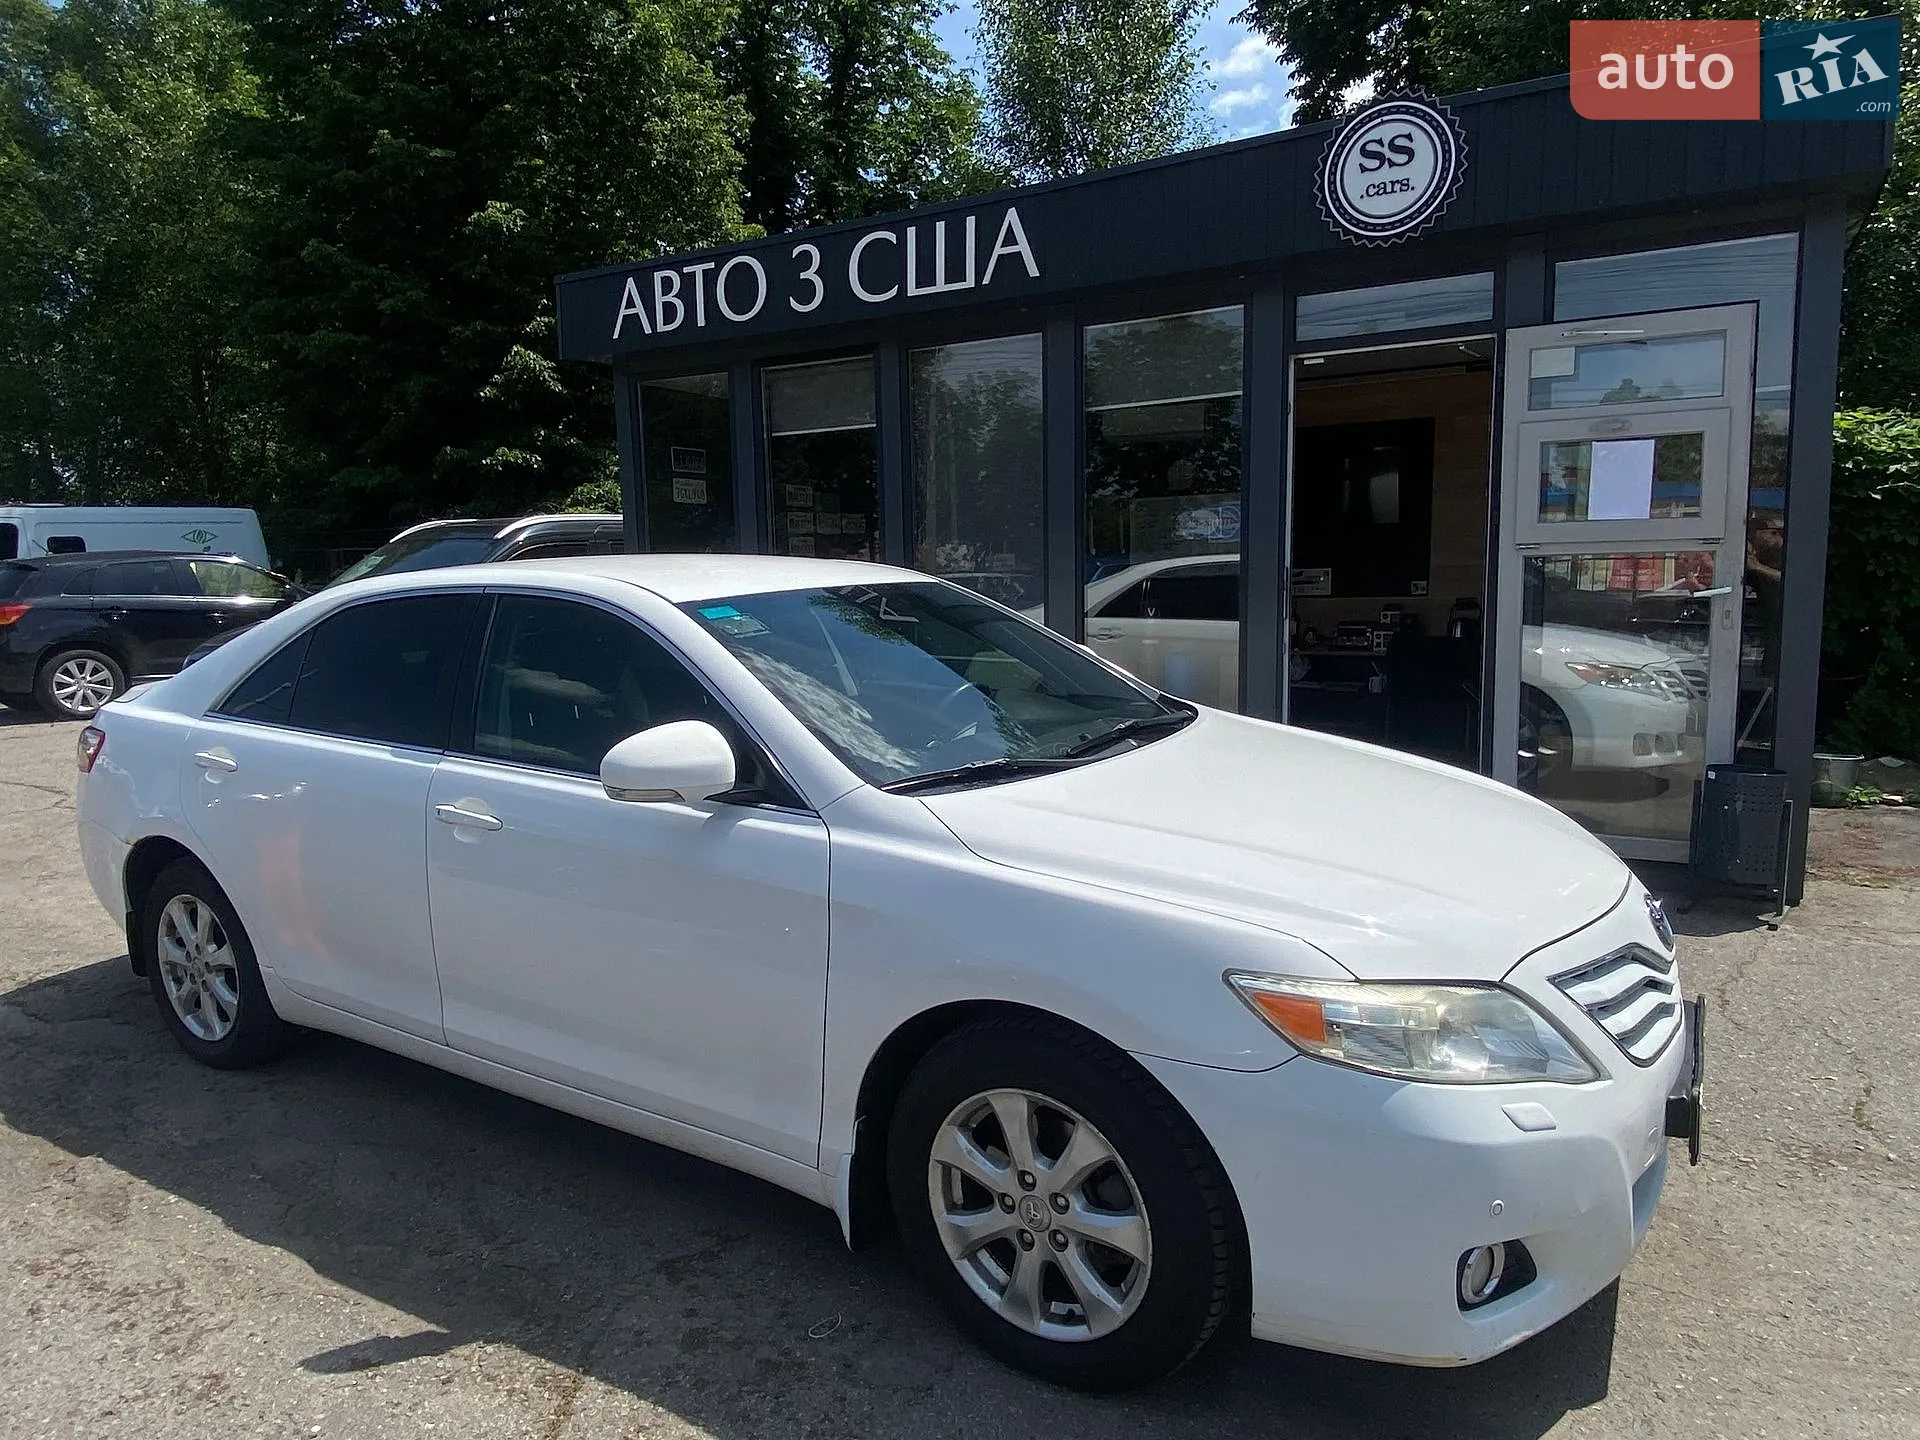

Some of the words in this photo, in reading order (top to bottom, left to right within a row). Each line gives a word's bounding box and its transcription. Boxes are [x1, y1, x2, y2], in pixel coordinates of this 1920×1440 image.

[1358, 132, 1415, 174] SS
[612, 255, 768, 340] АВТО
[847, 206, 1041, 303] США
